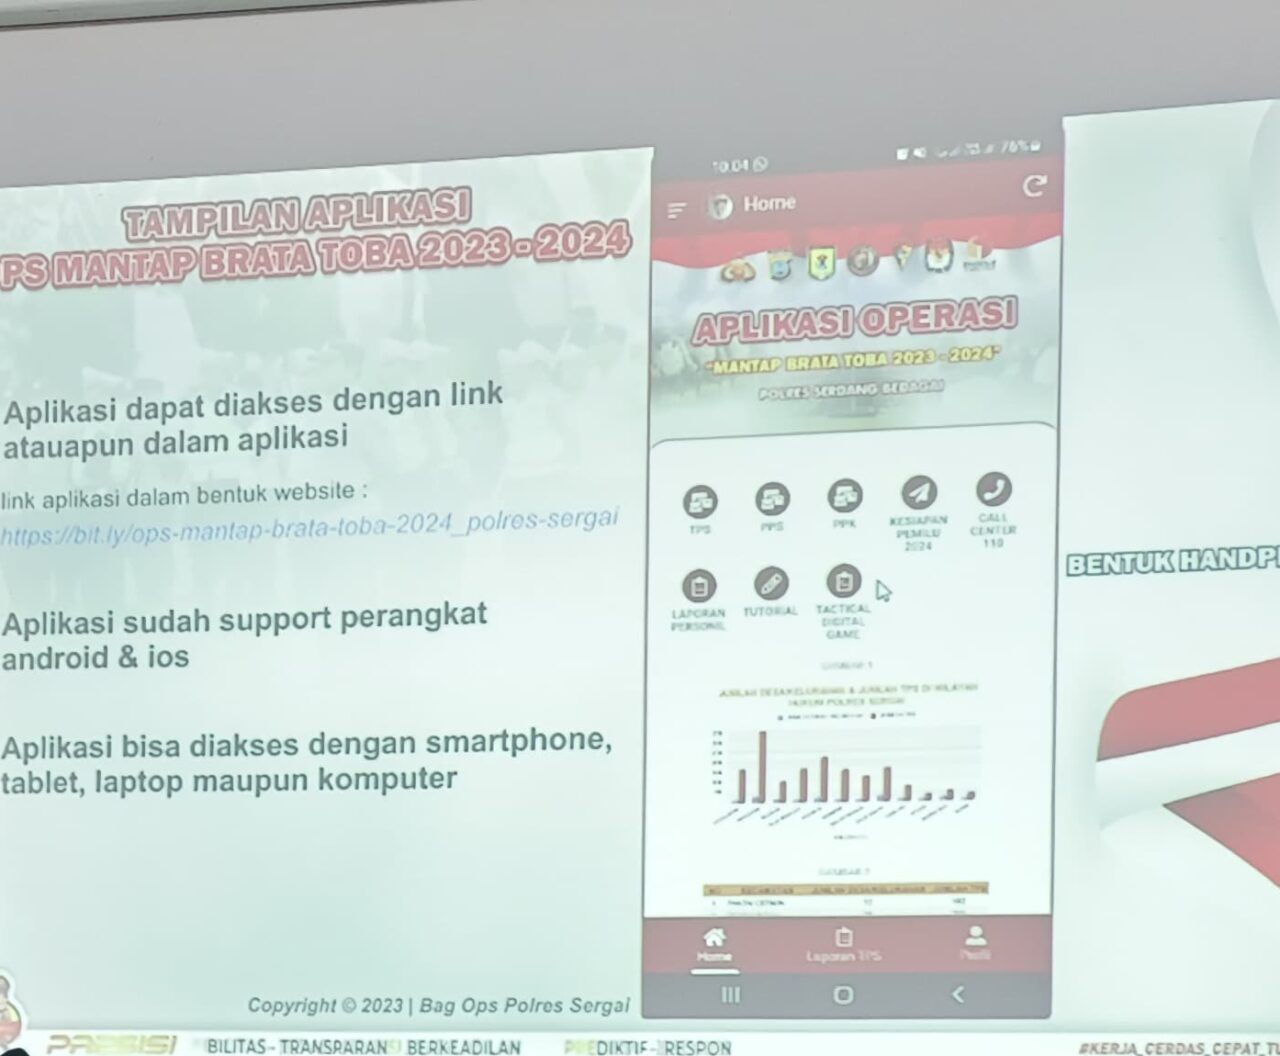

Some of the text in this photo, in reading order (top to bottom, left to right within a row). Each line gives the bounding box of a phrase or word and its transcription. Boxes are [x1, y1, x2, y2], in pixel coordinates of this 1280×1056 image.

[121, 186, 474, 243] TAMPILAN APLIKASI
[743, 195, 797, 212] Home
[51, 246, 198, 290] MANTAP
[199, 240, 316, 280] BRATA
[318, 232, 414, 274] TOBA
[417, 226, 513, 269] 2023
[532, 218, 634, 263] 2024
[691, 295, 1019, 347] APLIKASI OPERASI
[785, 354, 840, 373] BRATA
[843, 351, 889, 369] TOBA
[891, 349, 937, 367] 2023
[759, 378, 946, 401] POLRES SERDANG BEDAGAI
[4, 379, 504, 431] Aplikasi dapat diakses dengan link
[3, 422, 348, 464] atauapun dalam aplikasi
[1, 491, 36, 510] link
[42, 489, 120, 513] aplikasi
[127, 487, 190, 507] dalam
[197, 483, 267, 505] bentuk
[274, 481, 356, 502] website
[0, 505, 620, 549] https://bit.ly/ops-mantap-brata-toba-2024_polres-sergai
[689, 524, 711, 535] TPS
[760, 521, 784, 532] PPS
[978, 513, 1007, 523] CALL
[969, 525, 1017, 536] CENTER
[1066, 545, 1280, 577] BENTUK HANDP
[671, 608, 726, 620] LAPORAN
[743, 606, 799, 617] TUTORIAL
[816, 603, 871, 615] TACTICAL
[1, 601, 488, 643] Aplikasi sudah support perangkat
[821, 616, 866, 628] DIGITAL
[825, 629, 861, 640] GAME
[1, 644, 190, 671] android & ios
[1, 727, 612, 766] Aplikasi bisa diakses dengan smartphone,
[1, 767, 458, 799] tablet, laptop maupun komputer
[806, 950, 856, 963] Laporan
[247, 996, 338, 1017] Copyright
[361, 997, 404, 1014] 2023
[419, 997, 455, 1017] Bag
[461, 996, 499, 1017] Ops
[504, 996, 564, 1014] Polres
[569, 996, 632, 1018] Sergai
[406, 1039, 522, 1056] BERKEADILAN
